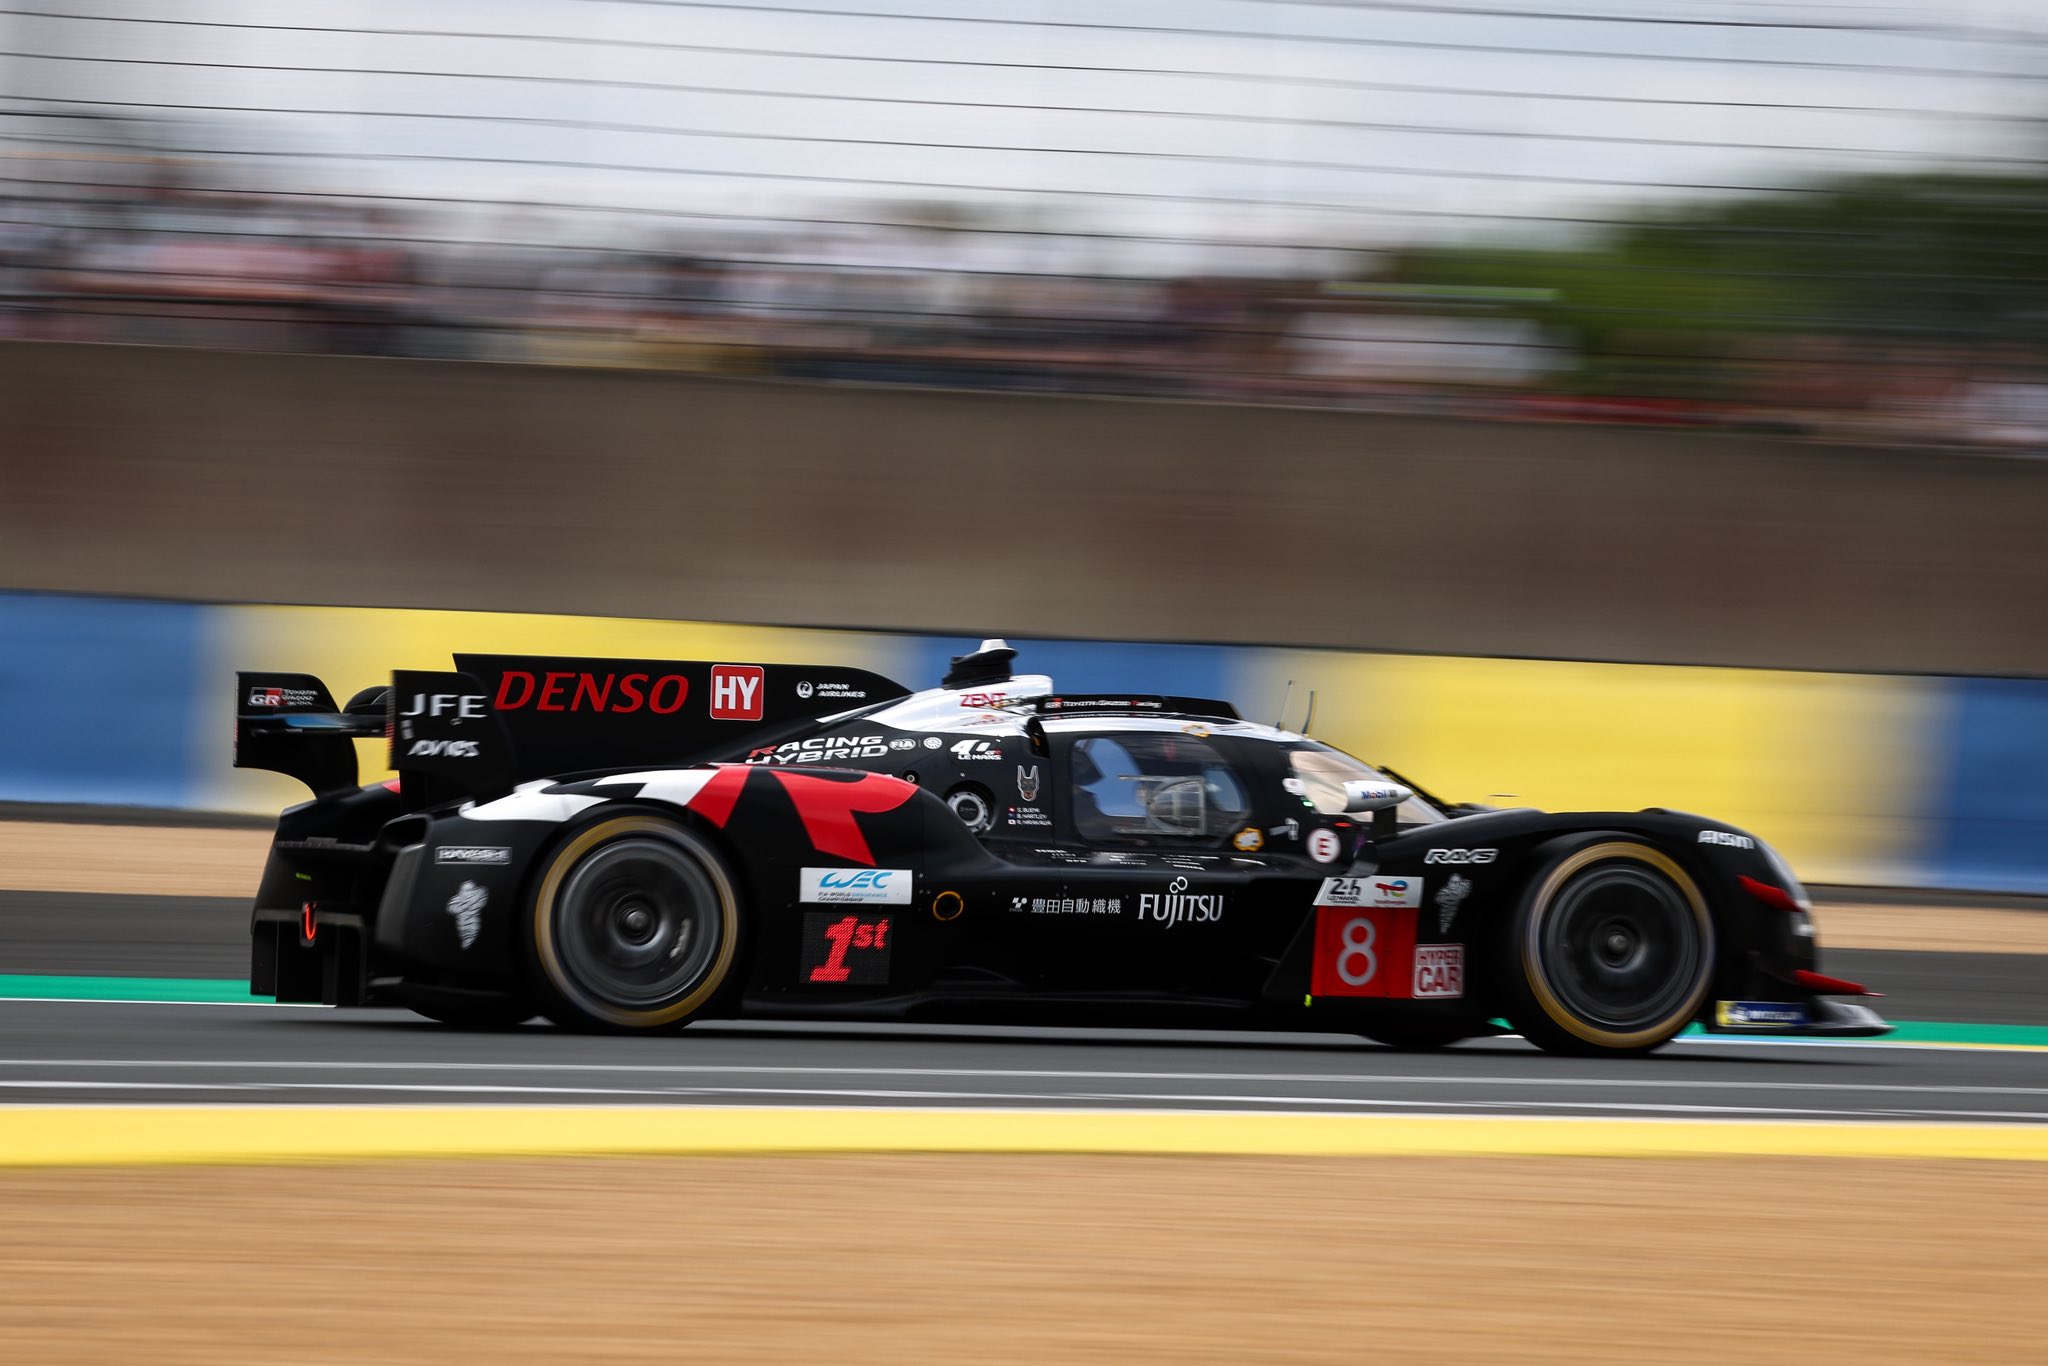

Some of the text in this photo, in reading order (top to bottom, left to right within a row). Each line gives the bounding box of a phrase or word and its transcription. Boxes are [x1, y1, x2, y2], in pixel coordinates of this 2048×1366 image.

[494, 671, 689, 714] DENSO
[714, 675, 760, 711] HY
[818, 690, 867, 698] AIRLINES
[960, 692, 1007, 707] ZENT
[399, 693, 488, 718] JFE
[745, 745, 888, 765] HYBRID
[748, 736, 884, 758] RACING
[889, 740, 913, 749] FIA
[1424, 848, 1499, 864] RAYS
[819, 870, 894, 889] WEC
[1138, 893, 1224, 929] FUJITSU
[809, 916, 889, 982] 1st
[1337, 917, 1378, 987] 8
[1418, 965, 1462, 993] CAR
